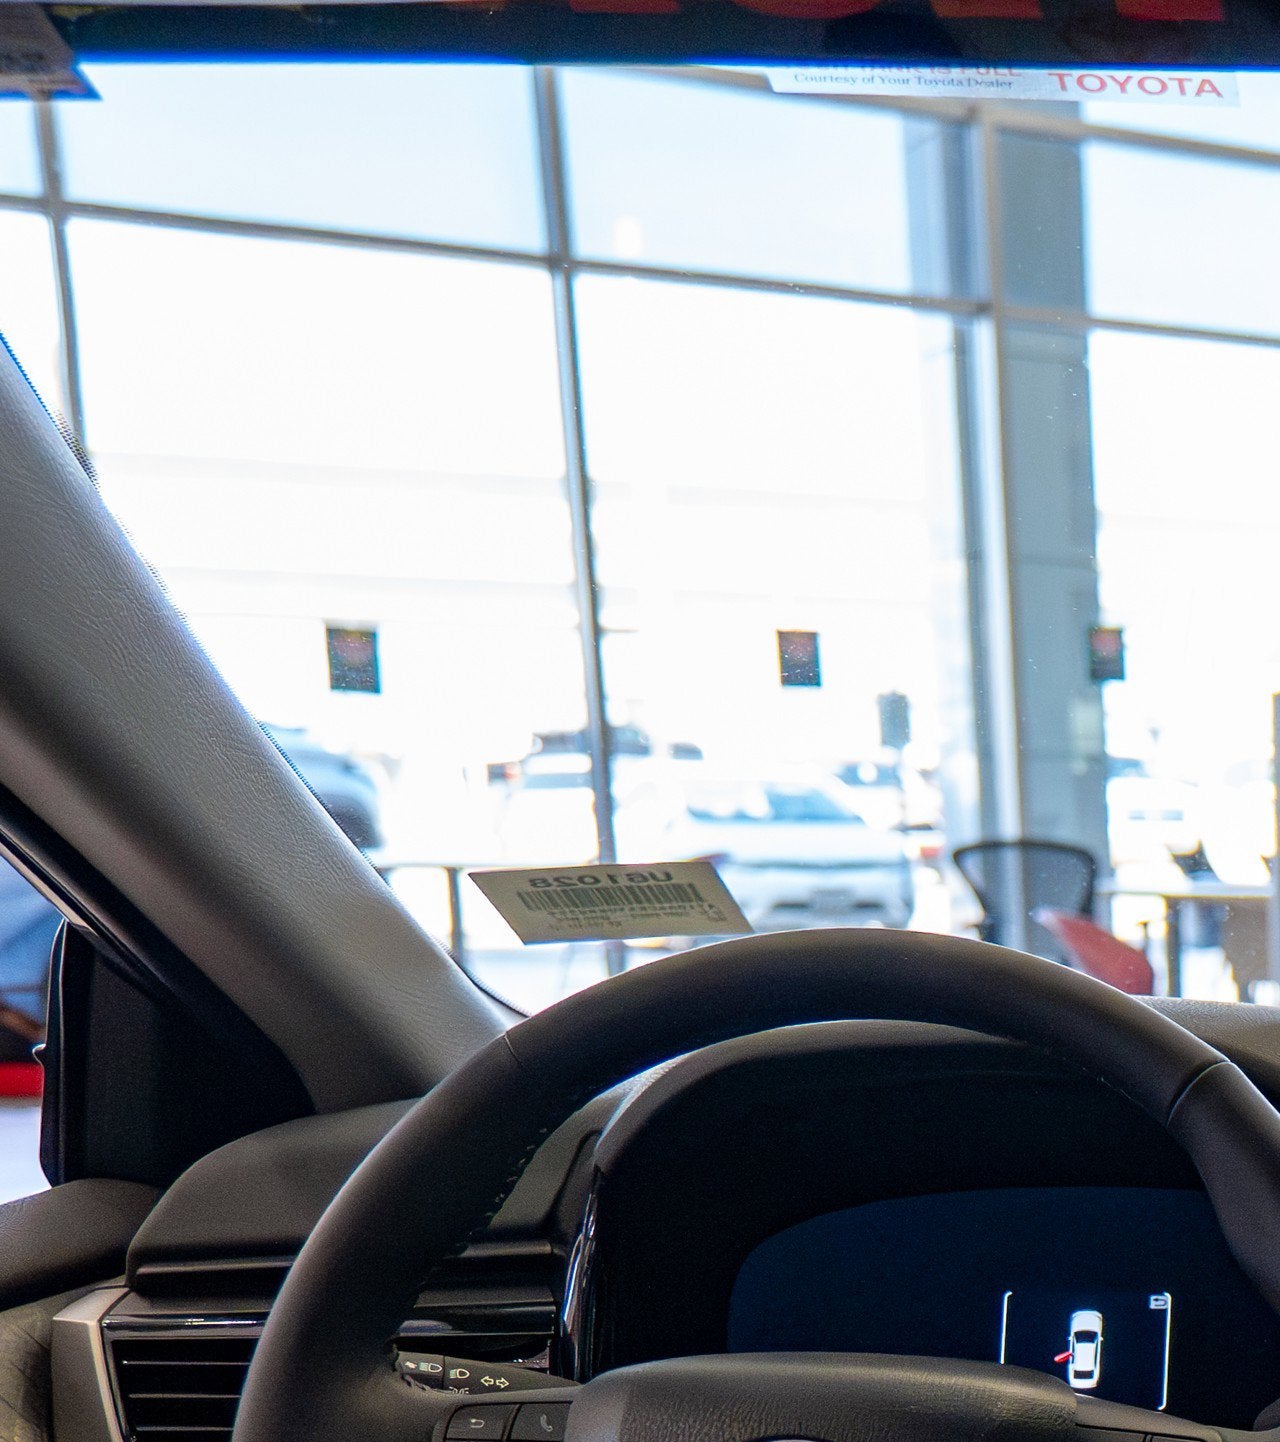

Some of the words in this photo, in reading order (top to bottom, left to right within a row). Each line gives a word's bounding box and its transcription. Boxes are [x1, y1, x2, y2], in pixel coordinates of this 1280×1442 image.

[794, 74, 858, 86] Courtesy
[862, 74, 874, 84] of
[877, 76, 910, 86] Your
[914, 76, 964, 88] Toyota
[968, 78, 1014, 89] Dealer
[1048, 72, 1224, 98] TOYOTA
